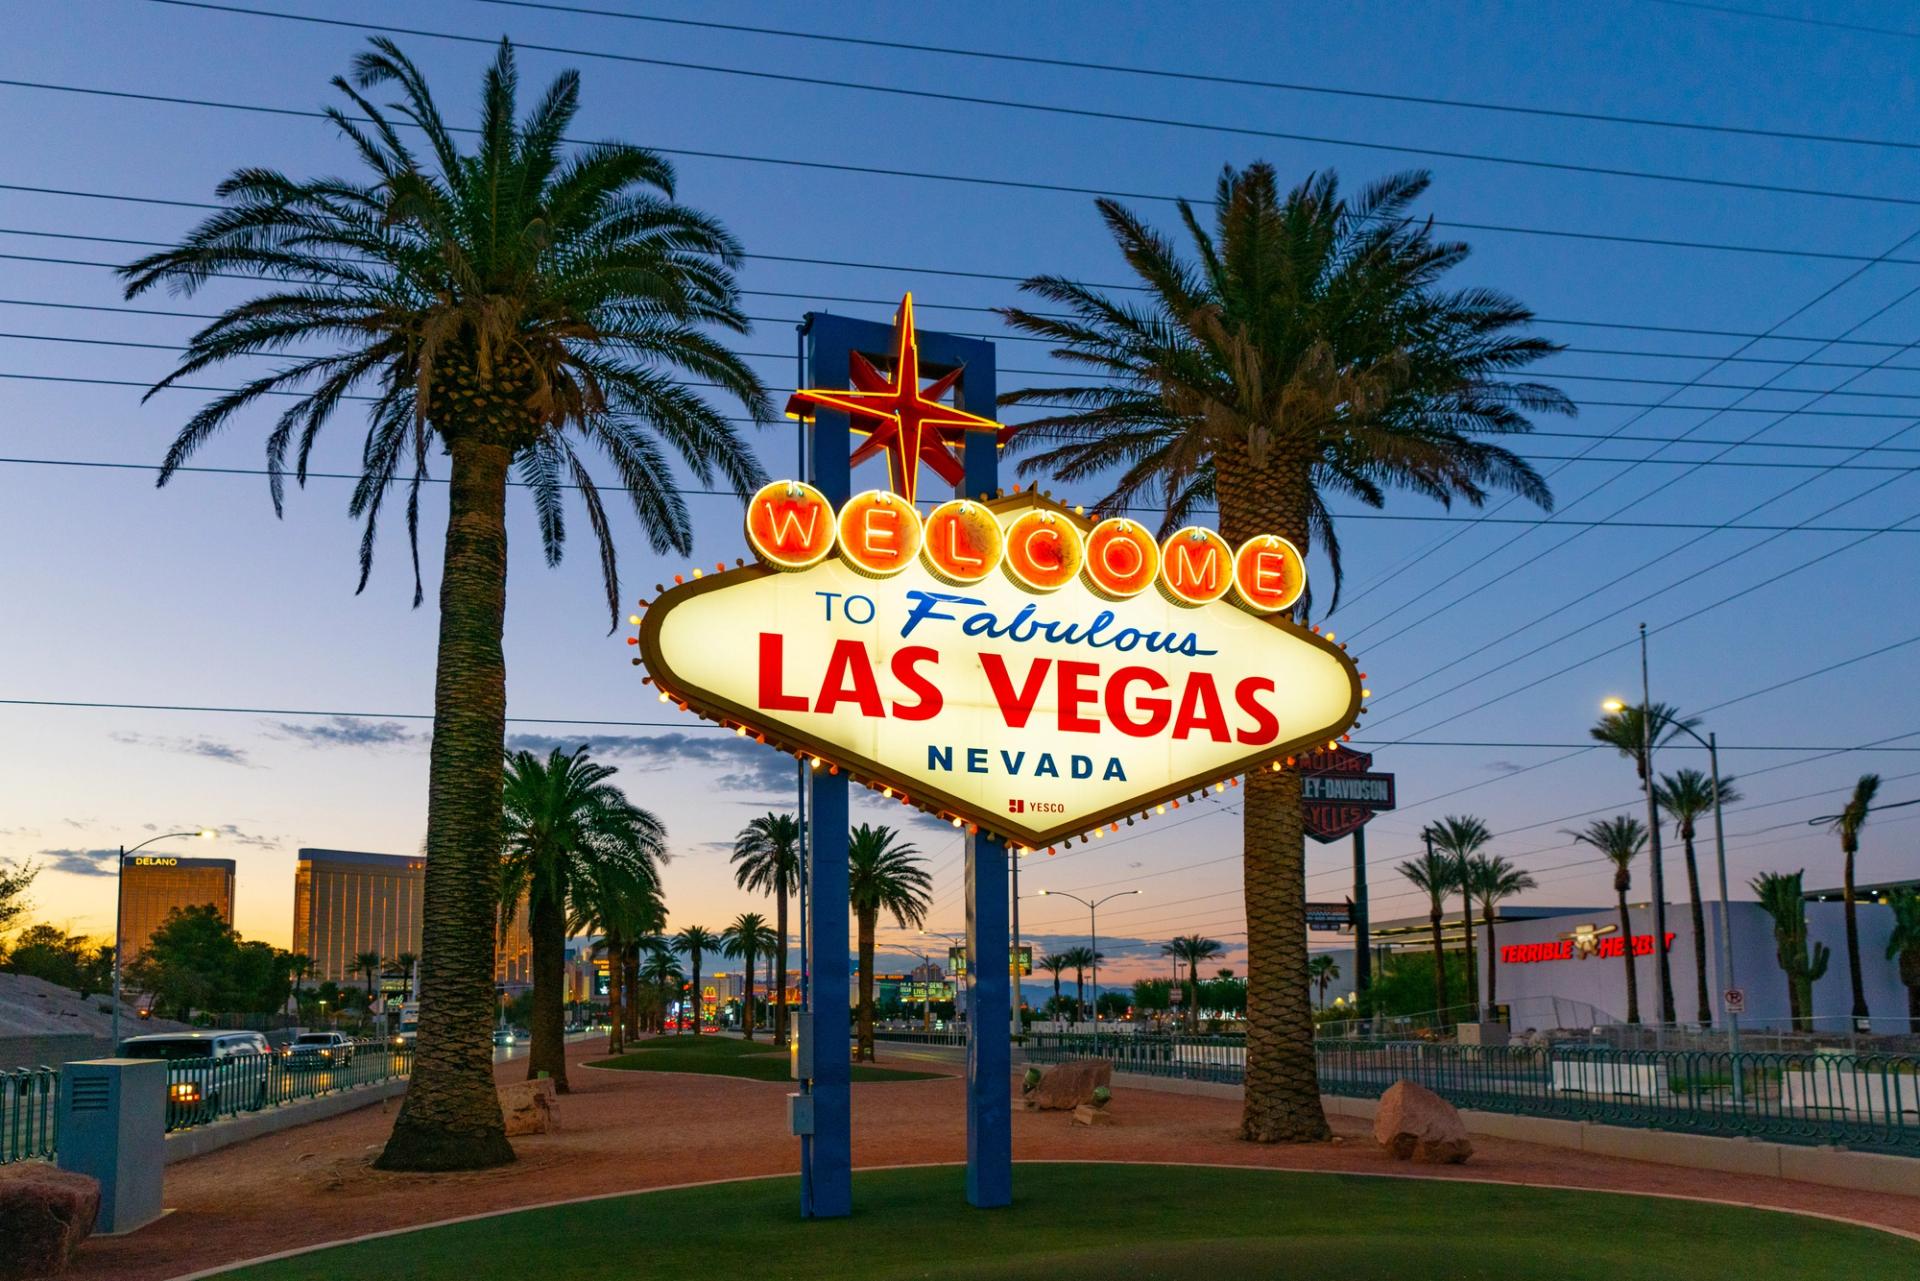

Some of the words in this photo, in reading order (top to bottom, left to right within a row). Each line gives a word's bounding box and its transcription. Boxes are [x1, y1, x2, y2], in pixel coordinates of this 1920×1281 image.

[763, 500, 1286, 597] WELCOME
[815, 591, 876, 625] TO
[900, 590, 1219, 657] Fabulous
[758, 632, 944, 721] LAS
[977, 652, 1280, 746] VEGAS
[927, 744, 1128, 782] NEVADA
[1300, 776, 1389, 801] LEY-DAVIDSON
[1029, 802, 1065, 814] YESCO
[1306, 805, 1361, 832] YCLES
[135, 857, 178, 866] DELANO
[1501, 939, 1575, 964] TERRIBLE
